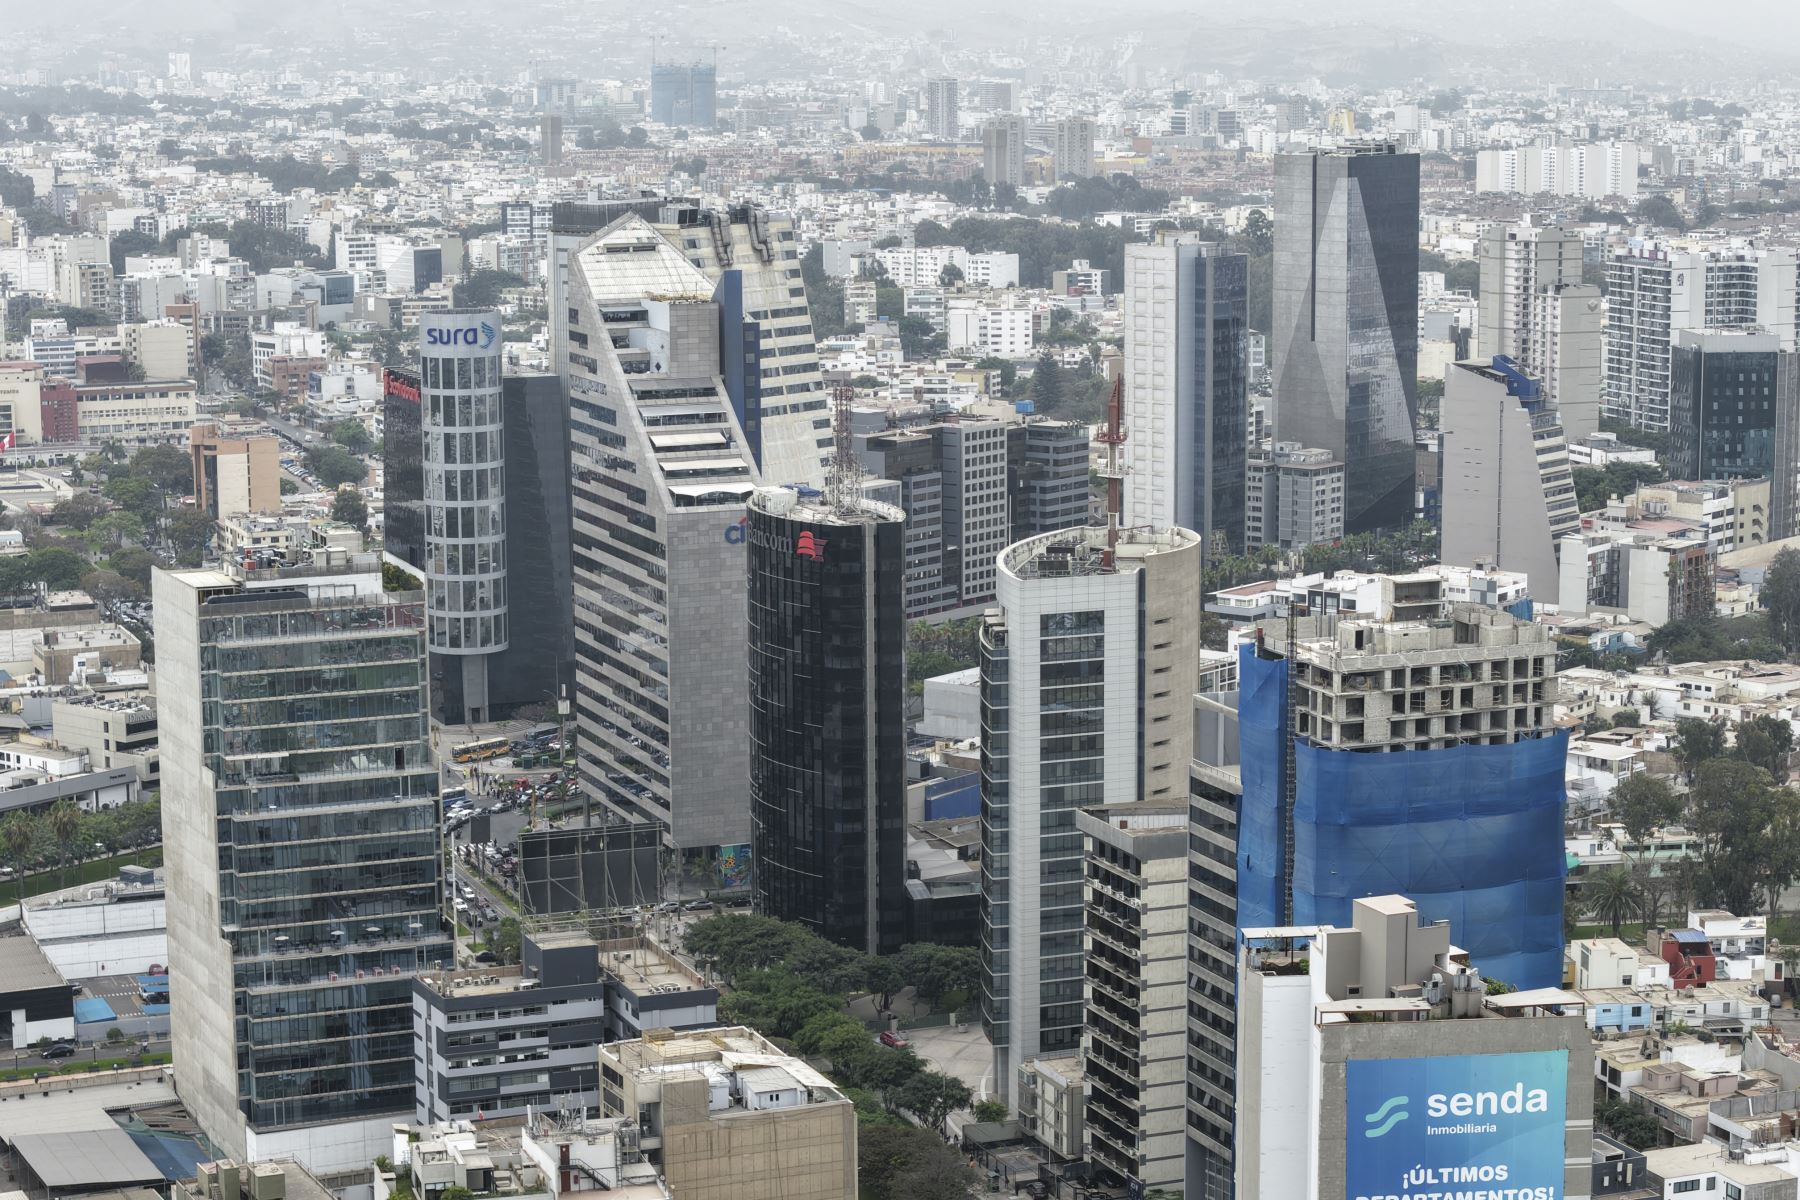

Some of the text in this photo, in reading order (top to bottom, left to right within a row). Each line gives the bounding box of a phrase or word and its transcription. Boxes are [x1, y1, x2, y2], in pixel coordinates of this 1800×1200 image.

[427, 328, 478, 345] sura
[748, 521, 793, 554] Bancom
[1427, 1082, 1548, 1118] senda
[1427, 1123, 1497, 1136] Inmobiliaria
[1403, 1164, 1509, 1190] ¡ÚLTIMOS
